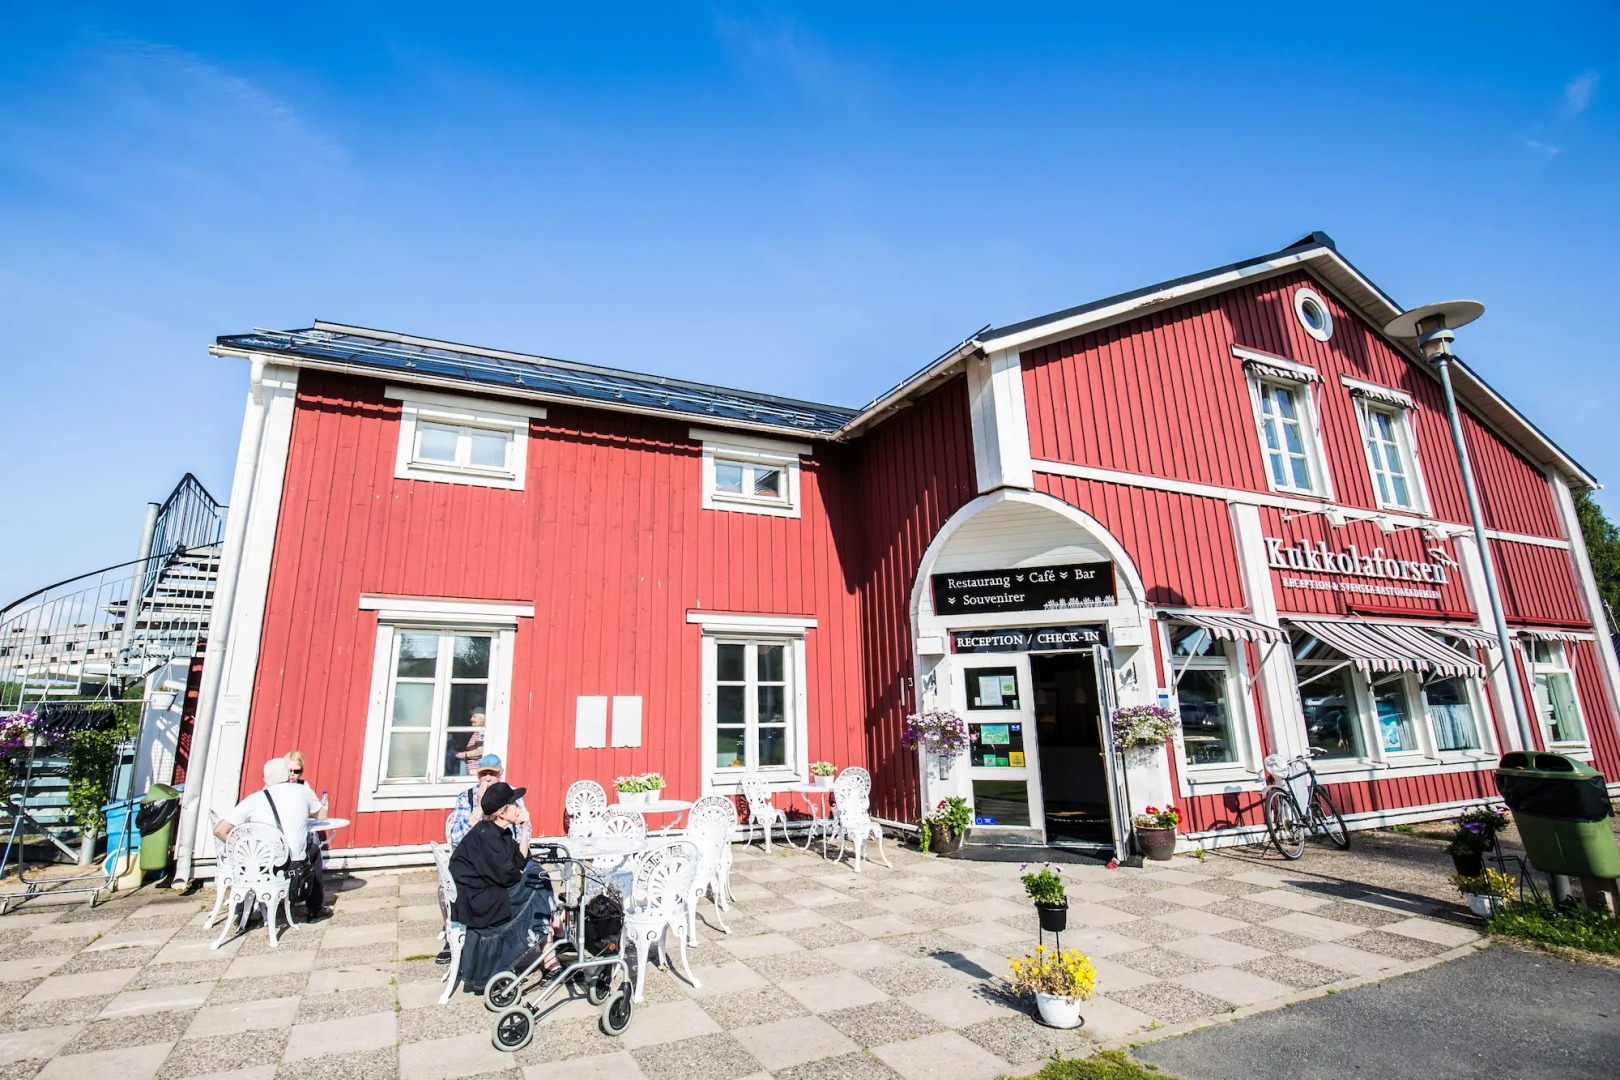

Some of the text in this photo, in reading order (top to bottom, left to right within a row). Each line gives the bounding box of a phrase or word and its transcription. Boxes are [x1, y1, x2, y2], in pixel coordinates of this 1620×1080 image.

[1265, 537, 1448, 583] Kukkolaforsen
[948, 568, 1096, 588] Restaurang Café Bar
[1282, 577, 1331, 591] RECEPTION
[1332, 581, 1340, 591] &
[1340, 582, 1376, 594] SVENSKA
[963, 592, 1025, 605] Souvenirer
[957, 635, 1023, 647] RECEPTION
[1037, 631, 1100, 643] CHECK-IN
